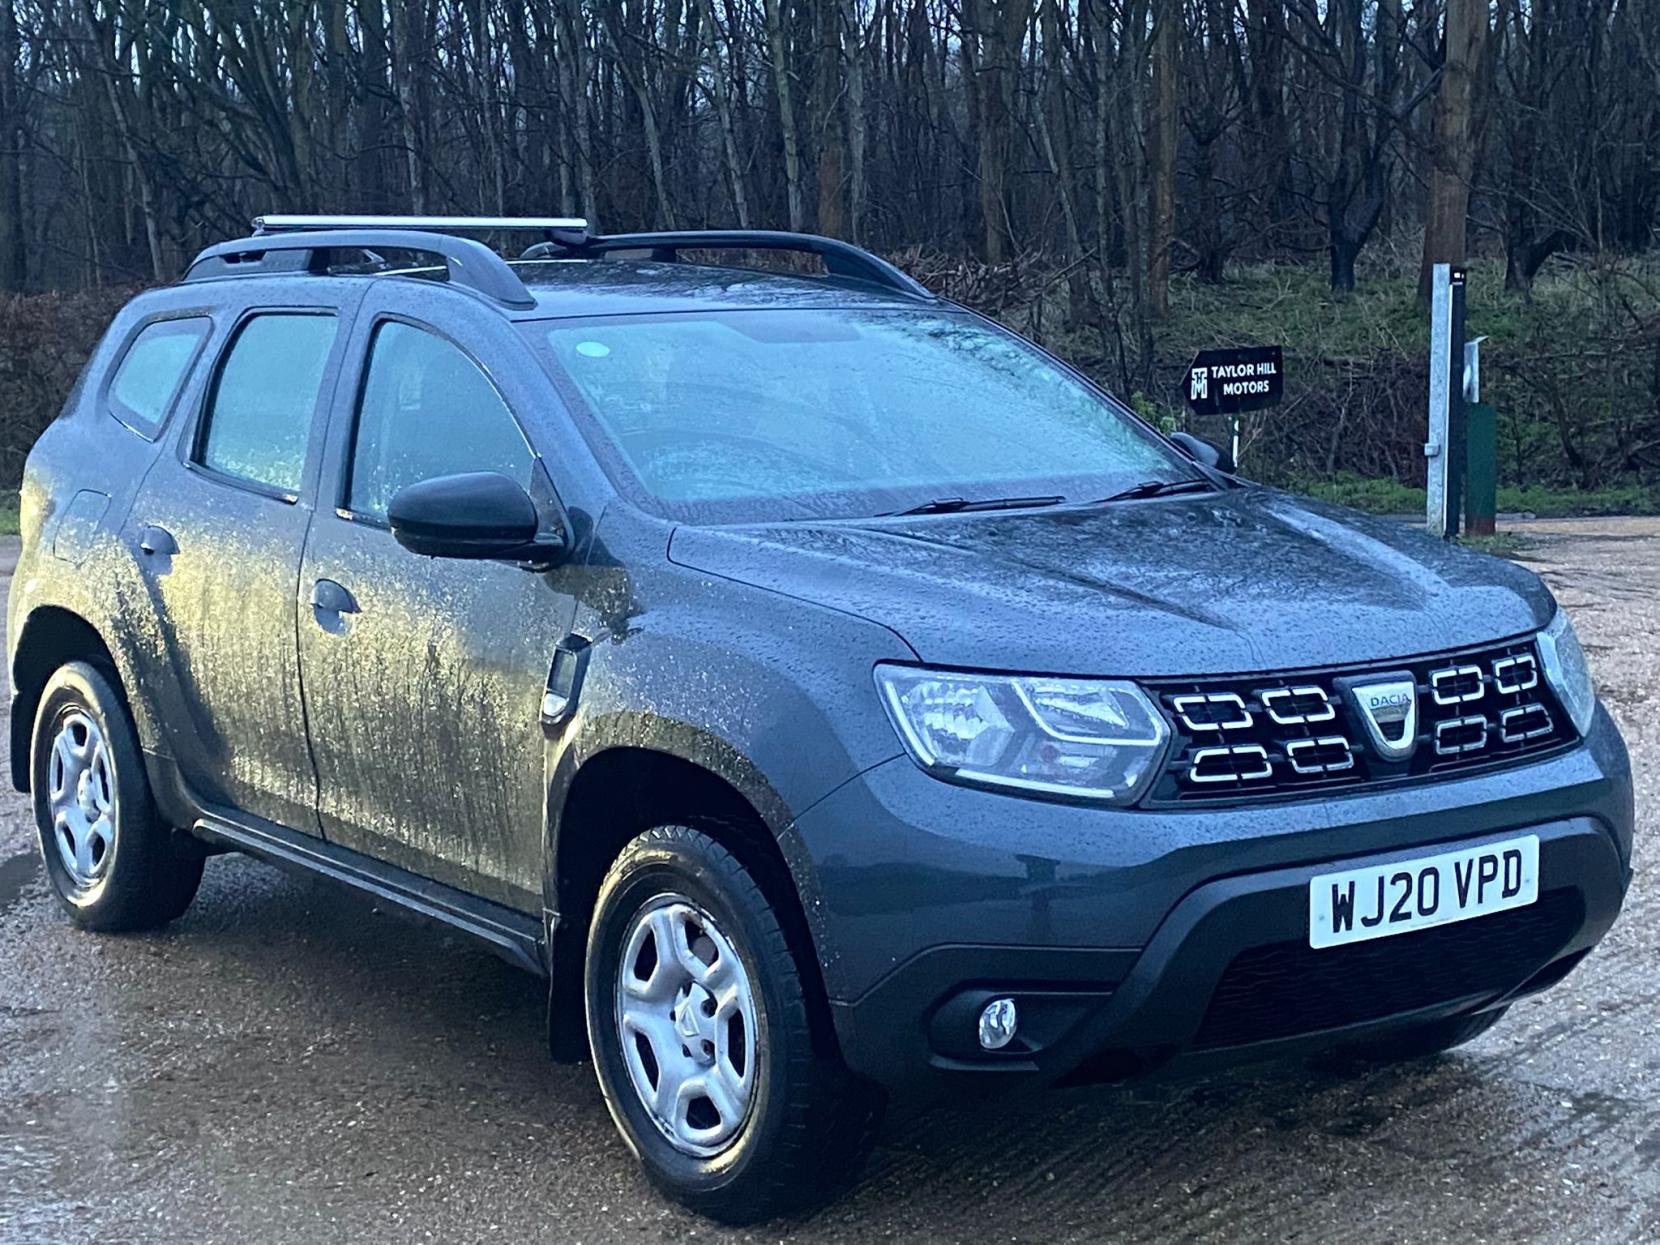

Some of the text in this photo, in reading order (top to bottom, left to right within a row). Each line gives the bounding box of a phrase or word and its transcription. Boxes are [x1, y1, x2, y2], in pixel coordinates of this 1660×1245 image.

[1211, 361, 1277, 379] TAYLOR HILL
[1223, 380, 1270, 395] MOTORS
[1370, 693, 1411, 707] DACIA
[1331, 849, 1522, 934] WJ20 VPD
